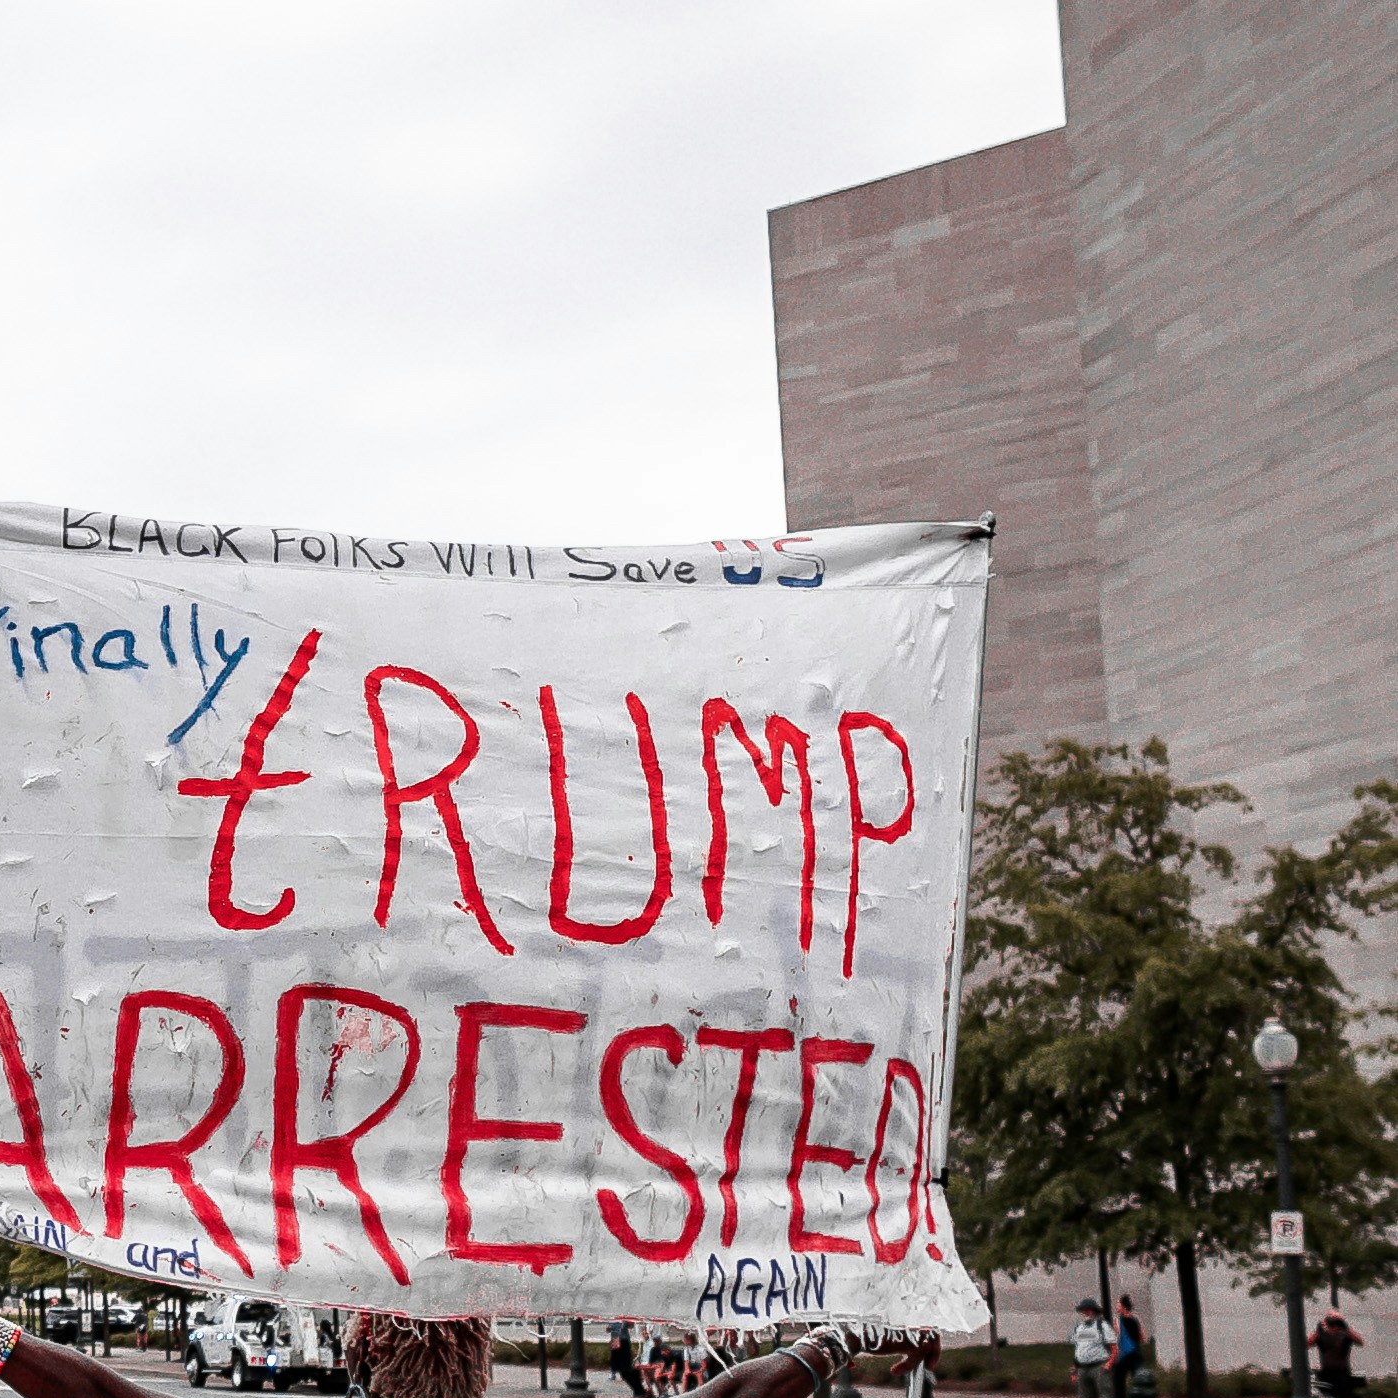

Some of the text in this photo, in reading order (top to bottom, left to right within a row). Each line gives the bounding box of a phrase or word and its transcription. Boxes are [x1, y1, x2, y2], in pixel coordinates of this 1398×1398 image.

[61, 506, 249, 564] BLACK
[429, 541, 535, 579] Will
[563, 546, 698, 584] Save
[711, 536, 826, 588] US
[177, 628, 916, 979] tRUMP
[125, 1239, 201, 1279] and
[696, 1253, 827, 1322] AGAIN
